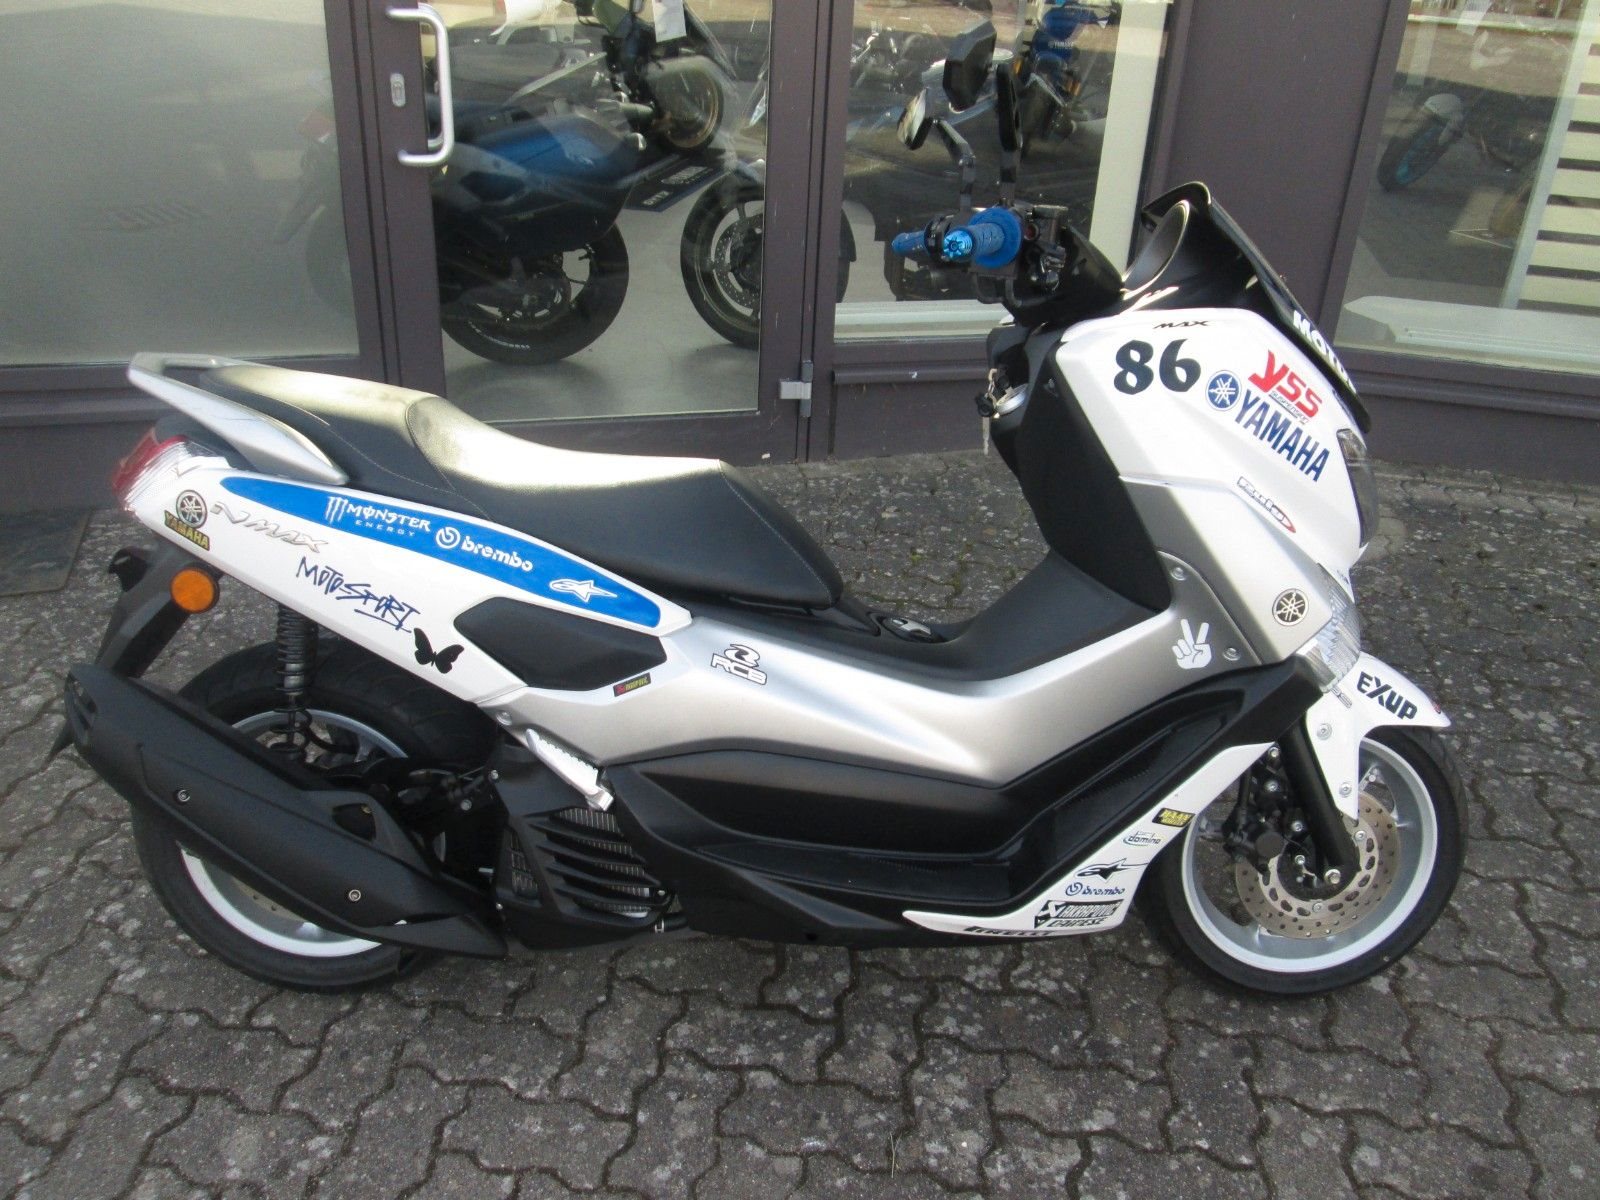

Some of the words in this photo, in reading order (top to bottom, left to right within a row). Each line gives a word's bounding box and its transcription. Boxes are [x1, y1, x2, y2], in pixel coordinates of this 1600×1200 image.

[1113, 338, 1201, 395] 86
[1247, 349, 1322, 418] YSS
[1235, 389, 1330, 482] YAMAHA
[164, 510, 210, 551] YAMAHA
[346, 504, 430, 532] MONSTER
[356, 519, 415, 537] ENERGY
[461, 535, 533, 572] brembo
[1356, 671, 1418, 720] EXUP
[1082, 886, 1125, 895] brembo
